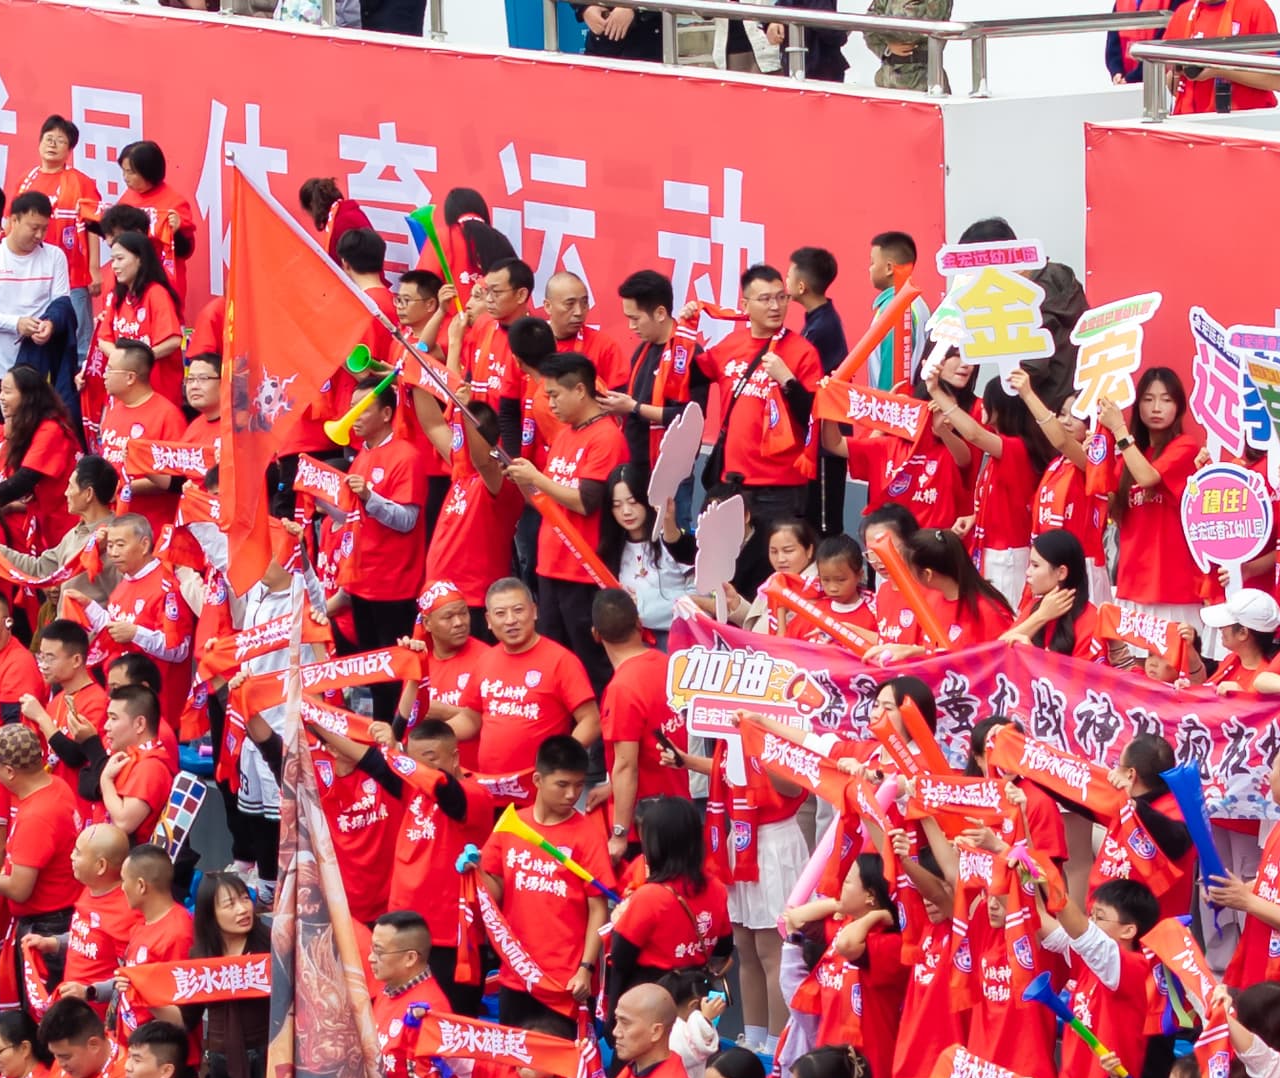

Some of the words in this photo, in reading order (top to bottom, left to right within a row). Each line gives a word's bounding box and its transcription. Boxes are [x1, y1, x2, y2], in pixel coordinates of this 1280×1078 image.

[941, 246, 1039, 269] 金宏远幼儿园
[956, 268, 1047, 358] 金
[1078, 329, 1138, 412] 宏
[847, 390, 920, 437] 彭水雄起
[150, 445, 208, 473] 彭水雄起
[1117, 605, 1168, 655] 彭水雄起
[678, 646, 773, 697] 加油
[761, 733, 821, 788] 彭水雄起
[921, 779, 1002, 814] 为彭水而战
[477, 884, 543, 994] 为彭水而战
[171, 959, 271, 1001] 彭水雄起
[437, 1020, 533, 1064] 彭水雄起
